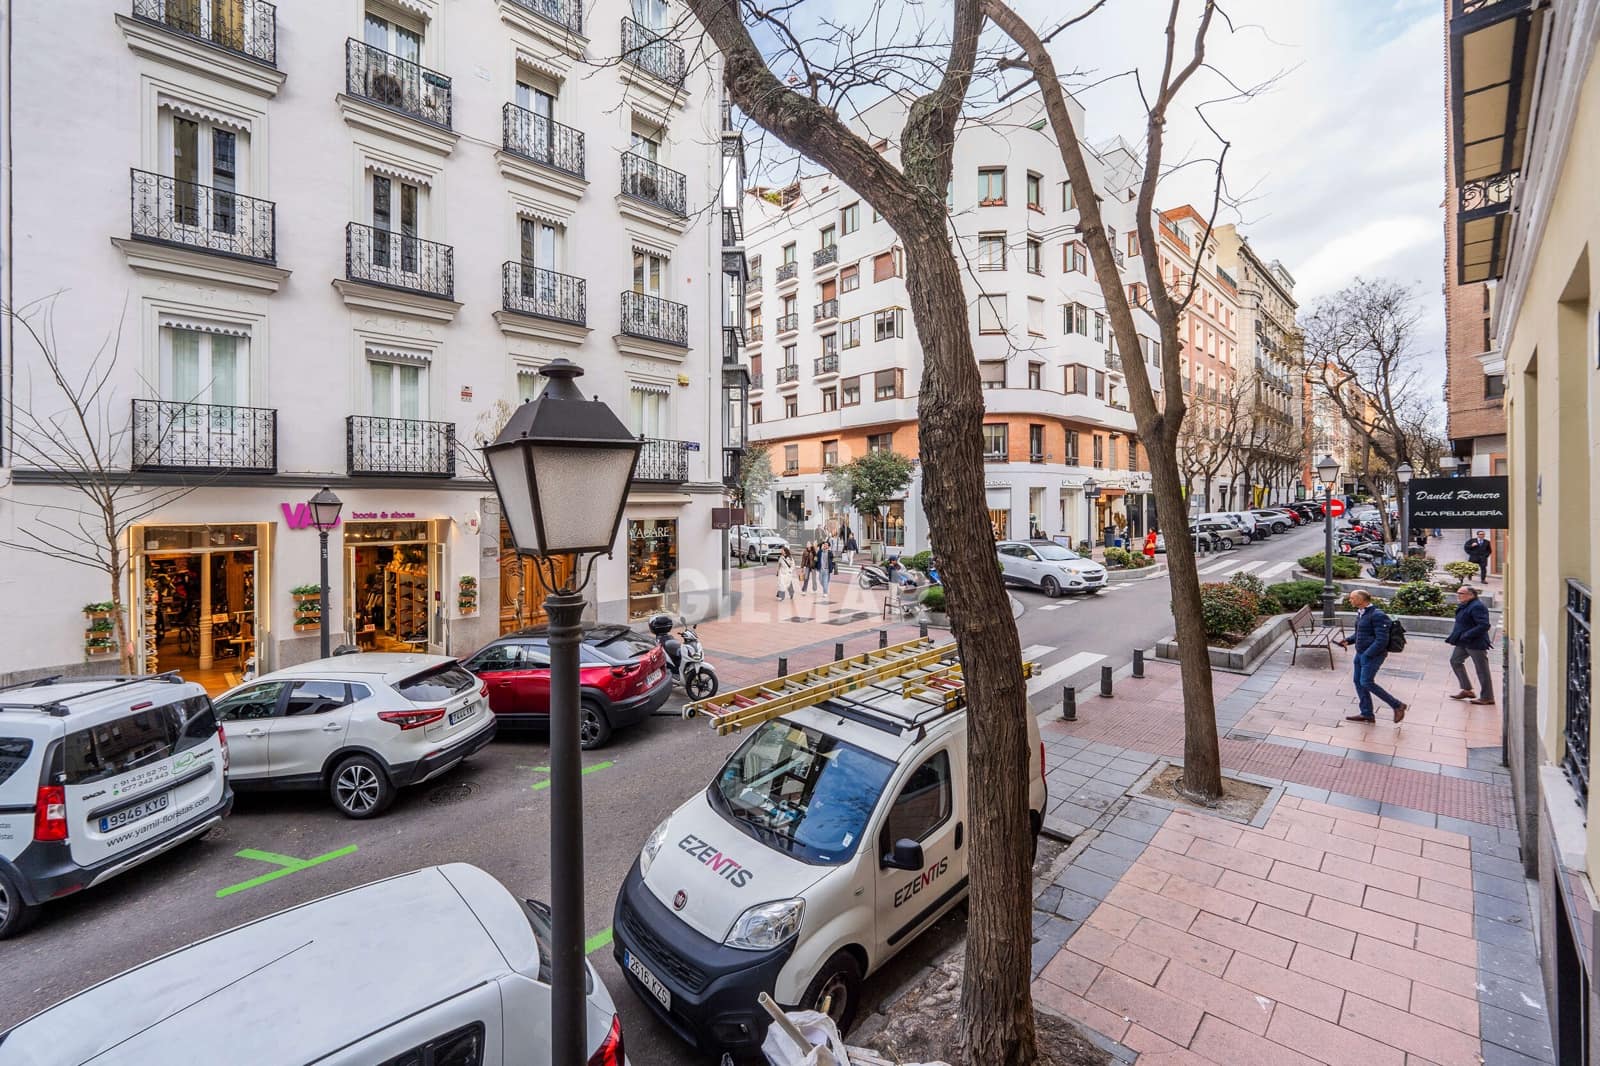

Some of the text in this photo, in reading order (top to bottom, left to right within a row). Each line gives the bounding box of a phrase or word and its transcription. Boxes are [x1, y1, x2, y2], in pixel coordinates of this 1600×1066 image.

[1415, 490, 1501, 500] Daniel Romero
[352, 511, 415, 519] boots & shoes
[109, 796, 167, 826] 9946 KYG
[678, 834, 753, 888] EZENTIS
[894, 856, 948, 908] EZENTIS
